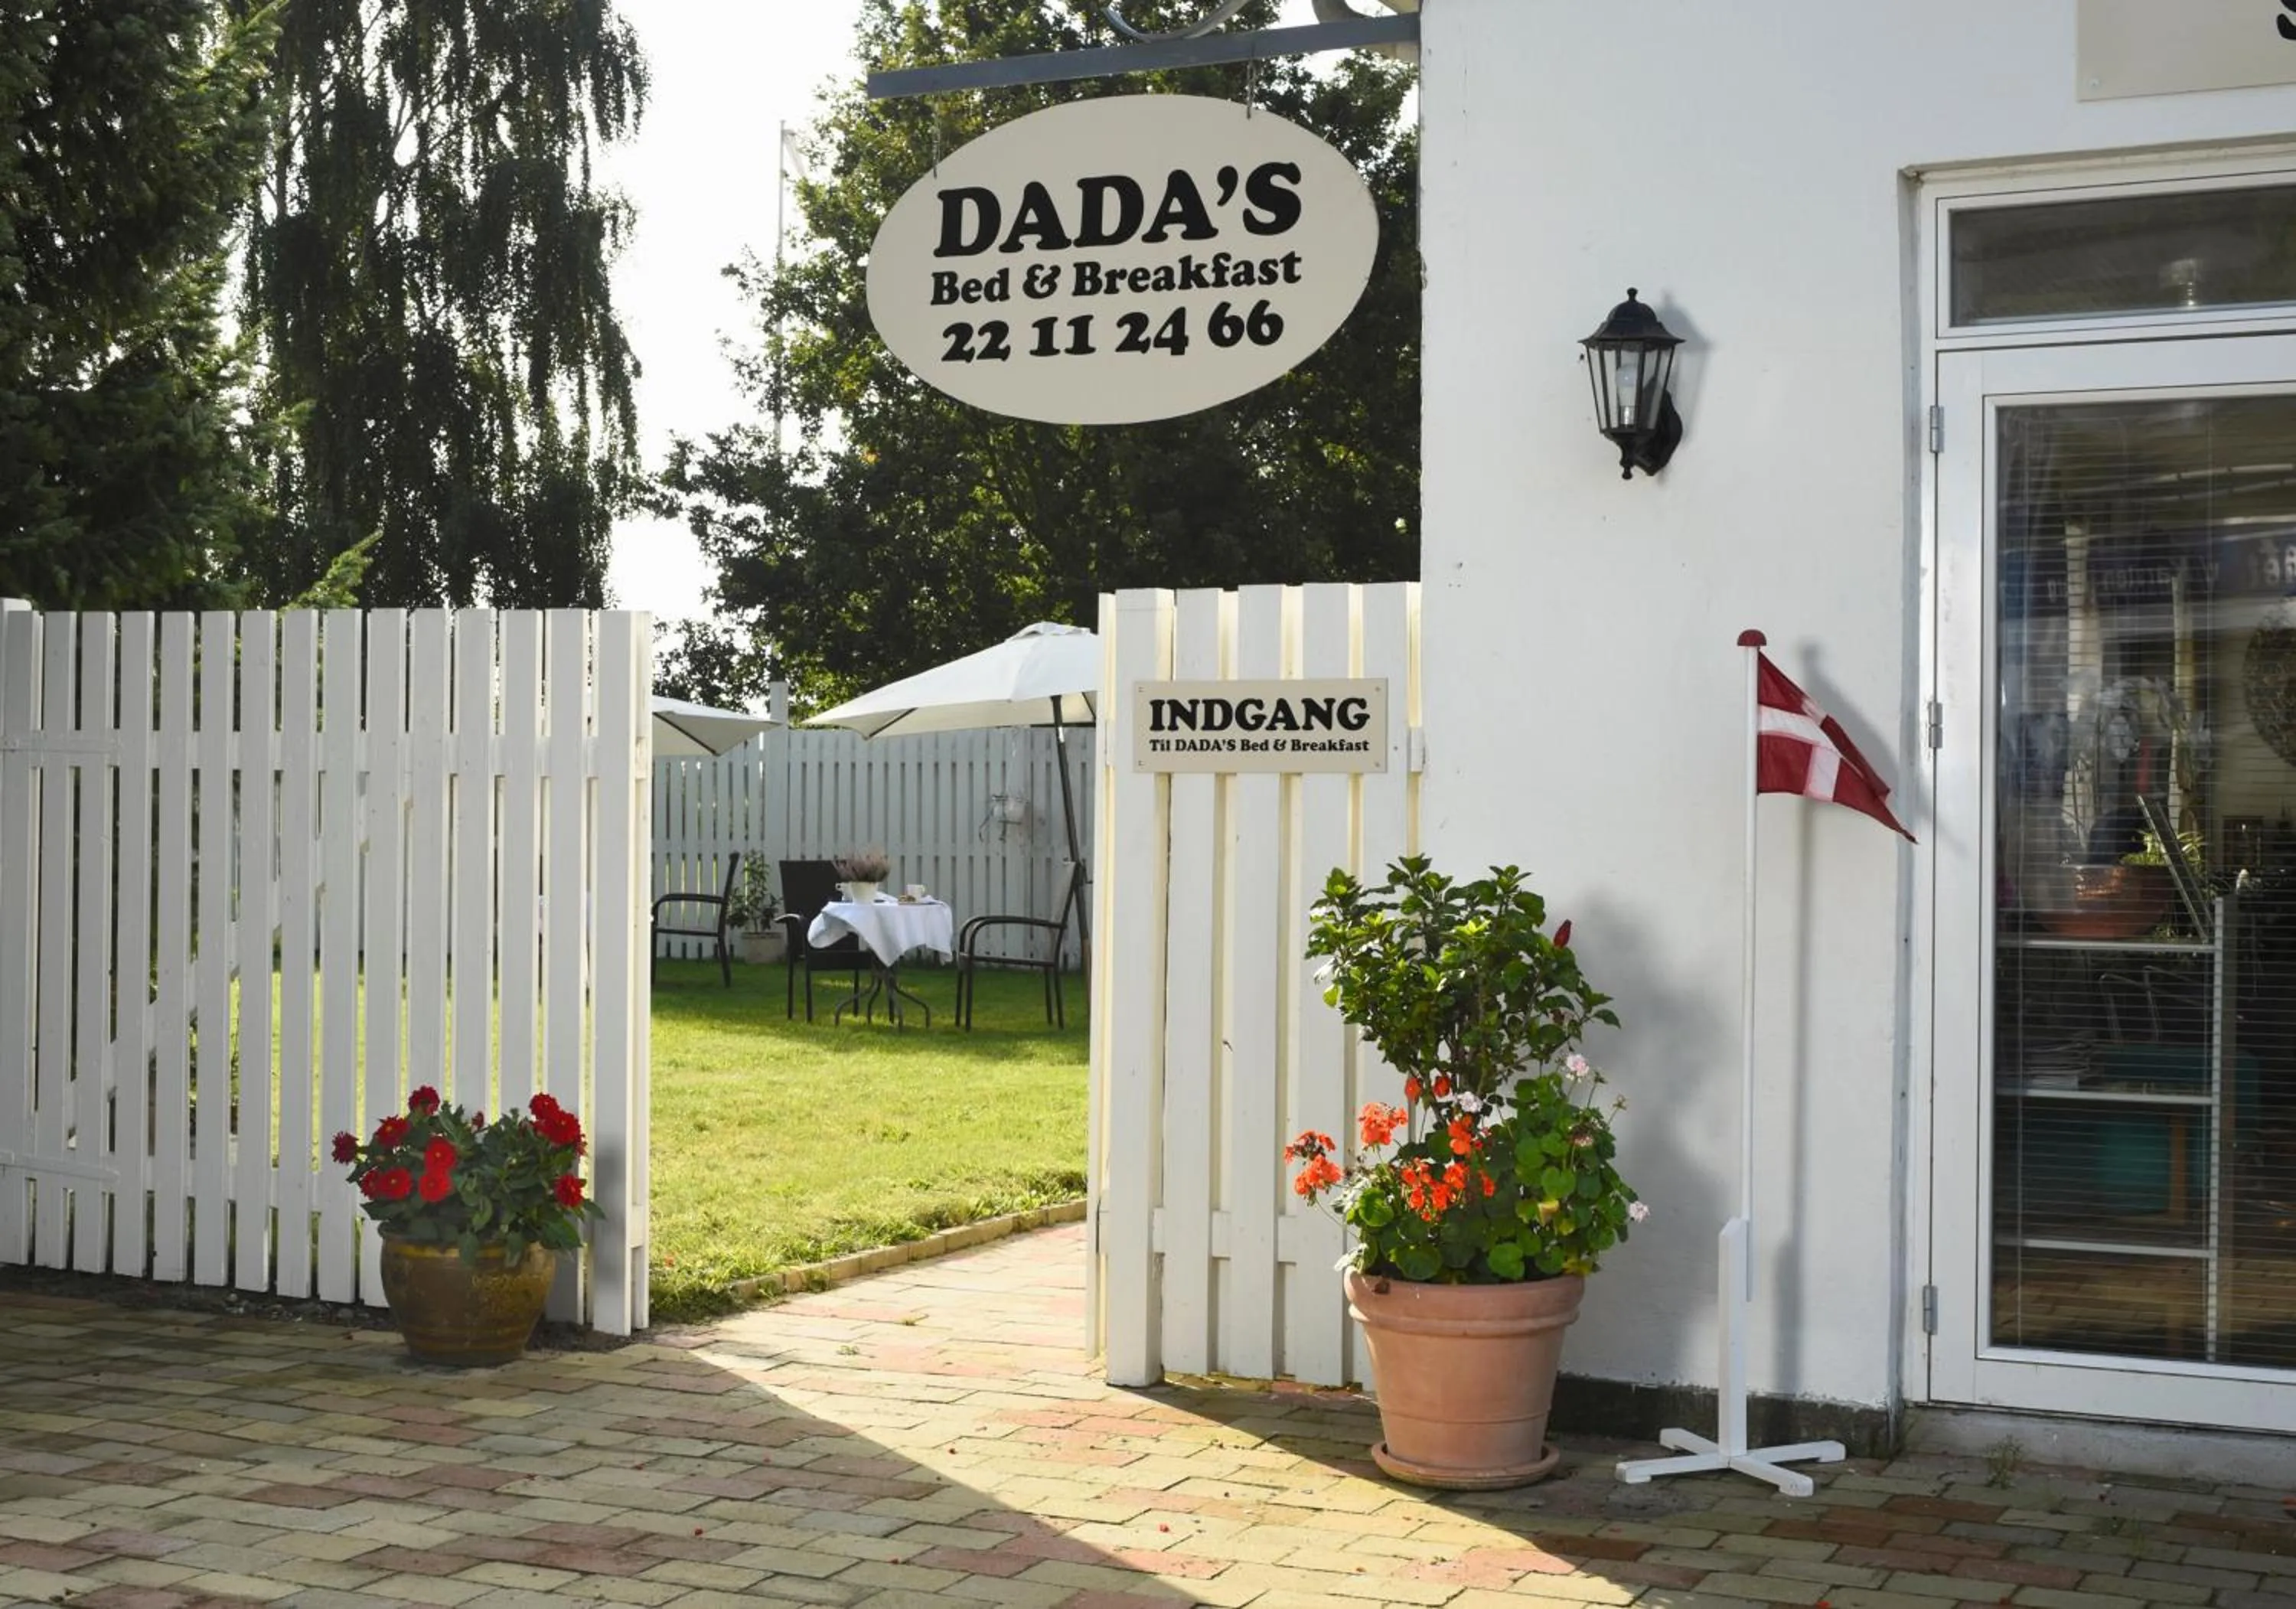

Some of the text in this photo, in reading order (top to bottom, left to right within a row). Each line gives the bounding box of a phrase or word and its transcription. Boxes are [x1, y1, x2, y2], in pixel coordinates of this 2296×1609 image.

[933, 162, 1302, 258] DADA'S
[930, 250, 1302, 306] Bed & Breakfast
[941, 299, 1284, 364] 22 11 24 66
[1149, 697, 1371, 732] INDGANG
[1149, 739, 1370, 752] Til DADA'S Bed & Breakfast
